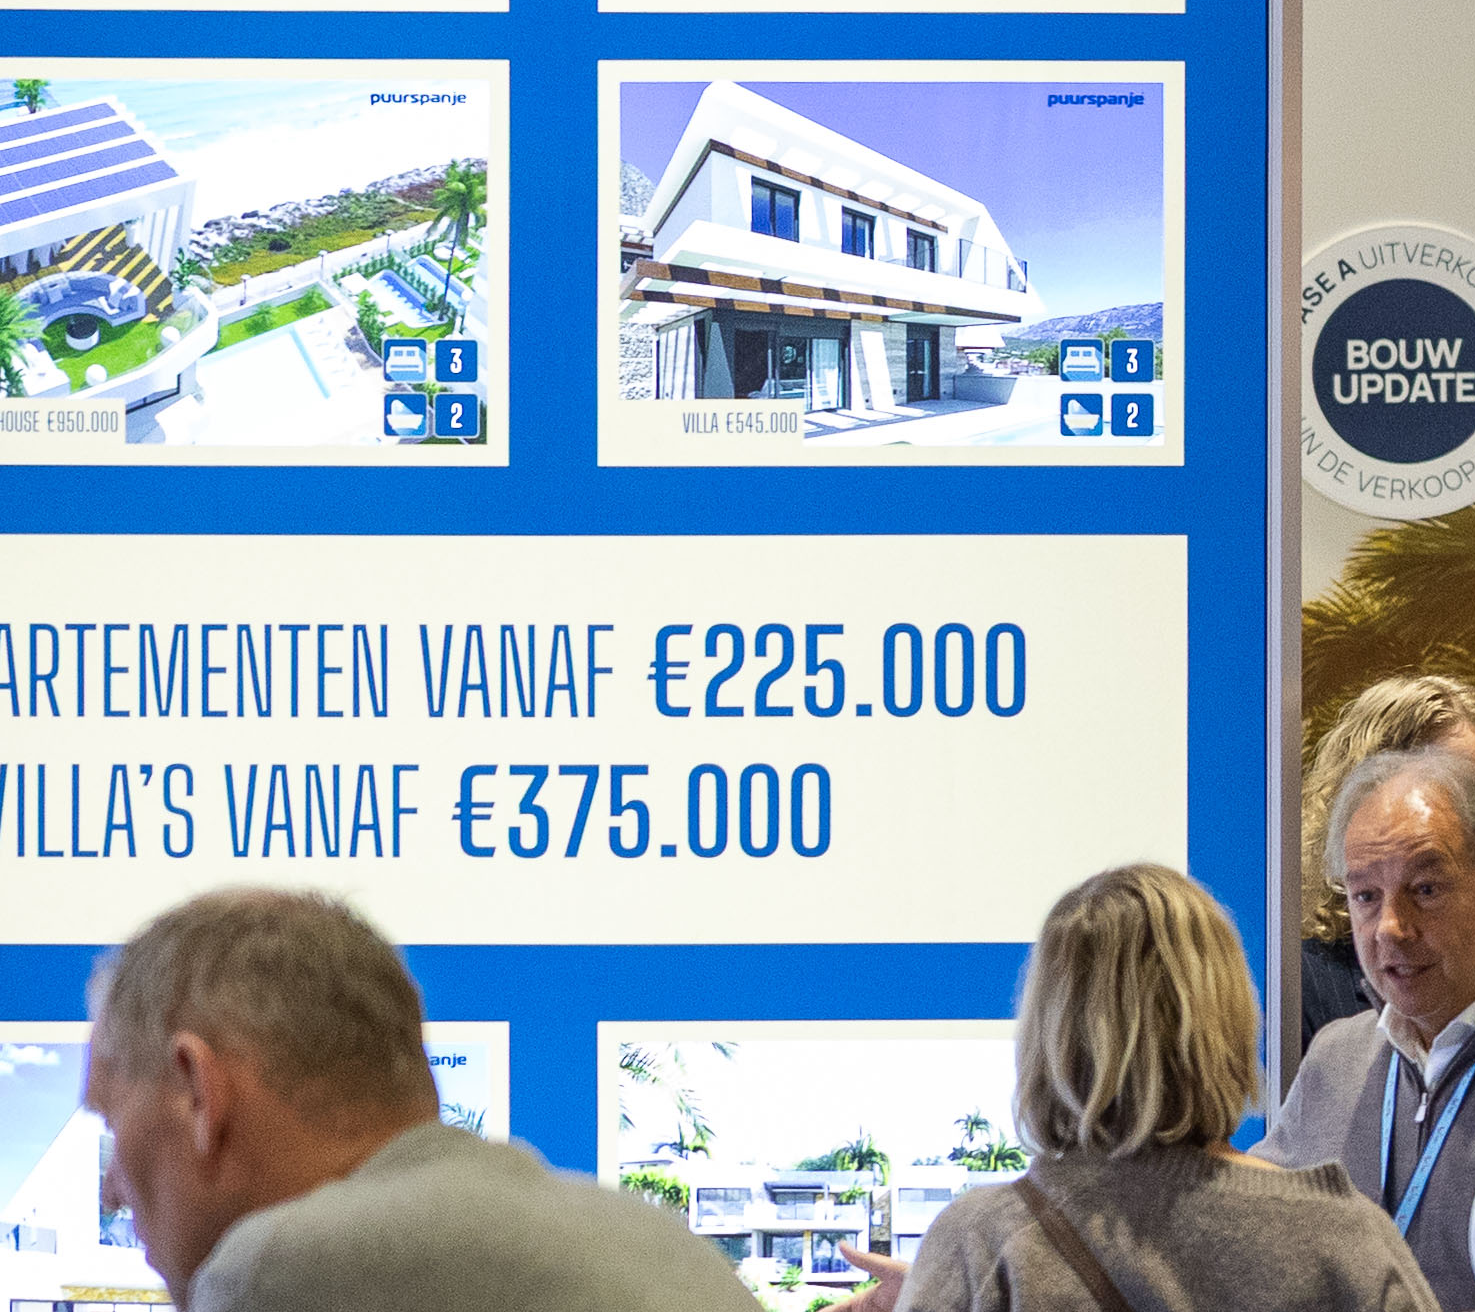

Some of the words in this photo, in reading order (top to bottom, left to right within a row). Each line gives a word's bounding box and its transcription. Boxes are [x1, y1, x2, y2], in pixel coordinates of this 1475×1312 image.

[370, 91, 467, 106] puurspanje
[1047, 92, 1146, 108] puurspanje
[1337, 258, 1357, 281] A
[449, 347, 463, 374] 3
[1126, 348, 1139, 375] 3
[1346, 338, 1463, 370] BOUW
[47, 410, 119, 433] €950.000
[449, 402, 463, 429] 2
[682, 410, 719, 434] VILLA
[726, 410, 798, 435] €545.000
[1126, 402, 1139, 429] 2
[1316, 449, 1355, 485] DE
[1357, 459, 1475, 502] VERKOOP
[418, 623, 616, 718] VANAF
[646, 621, 1029, 719] €225.000
[222, 763, 420, 859] VANAF
[451, 762, 834, 860] €375.000
